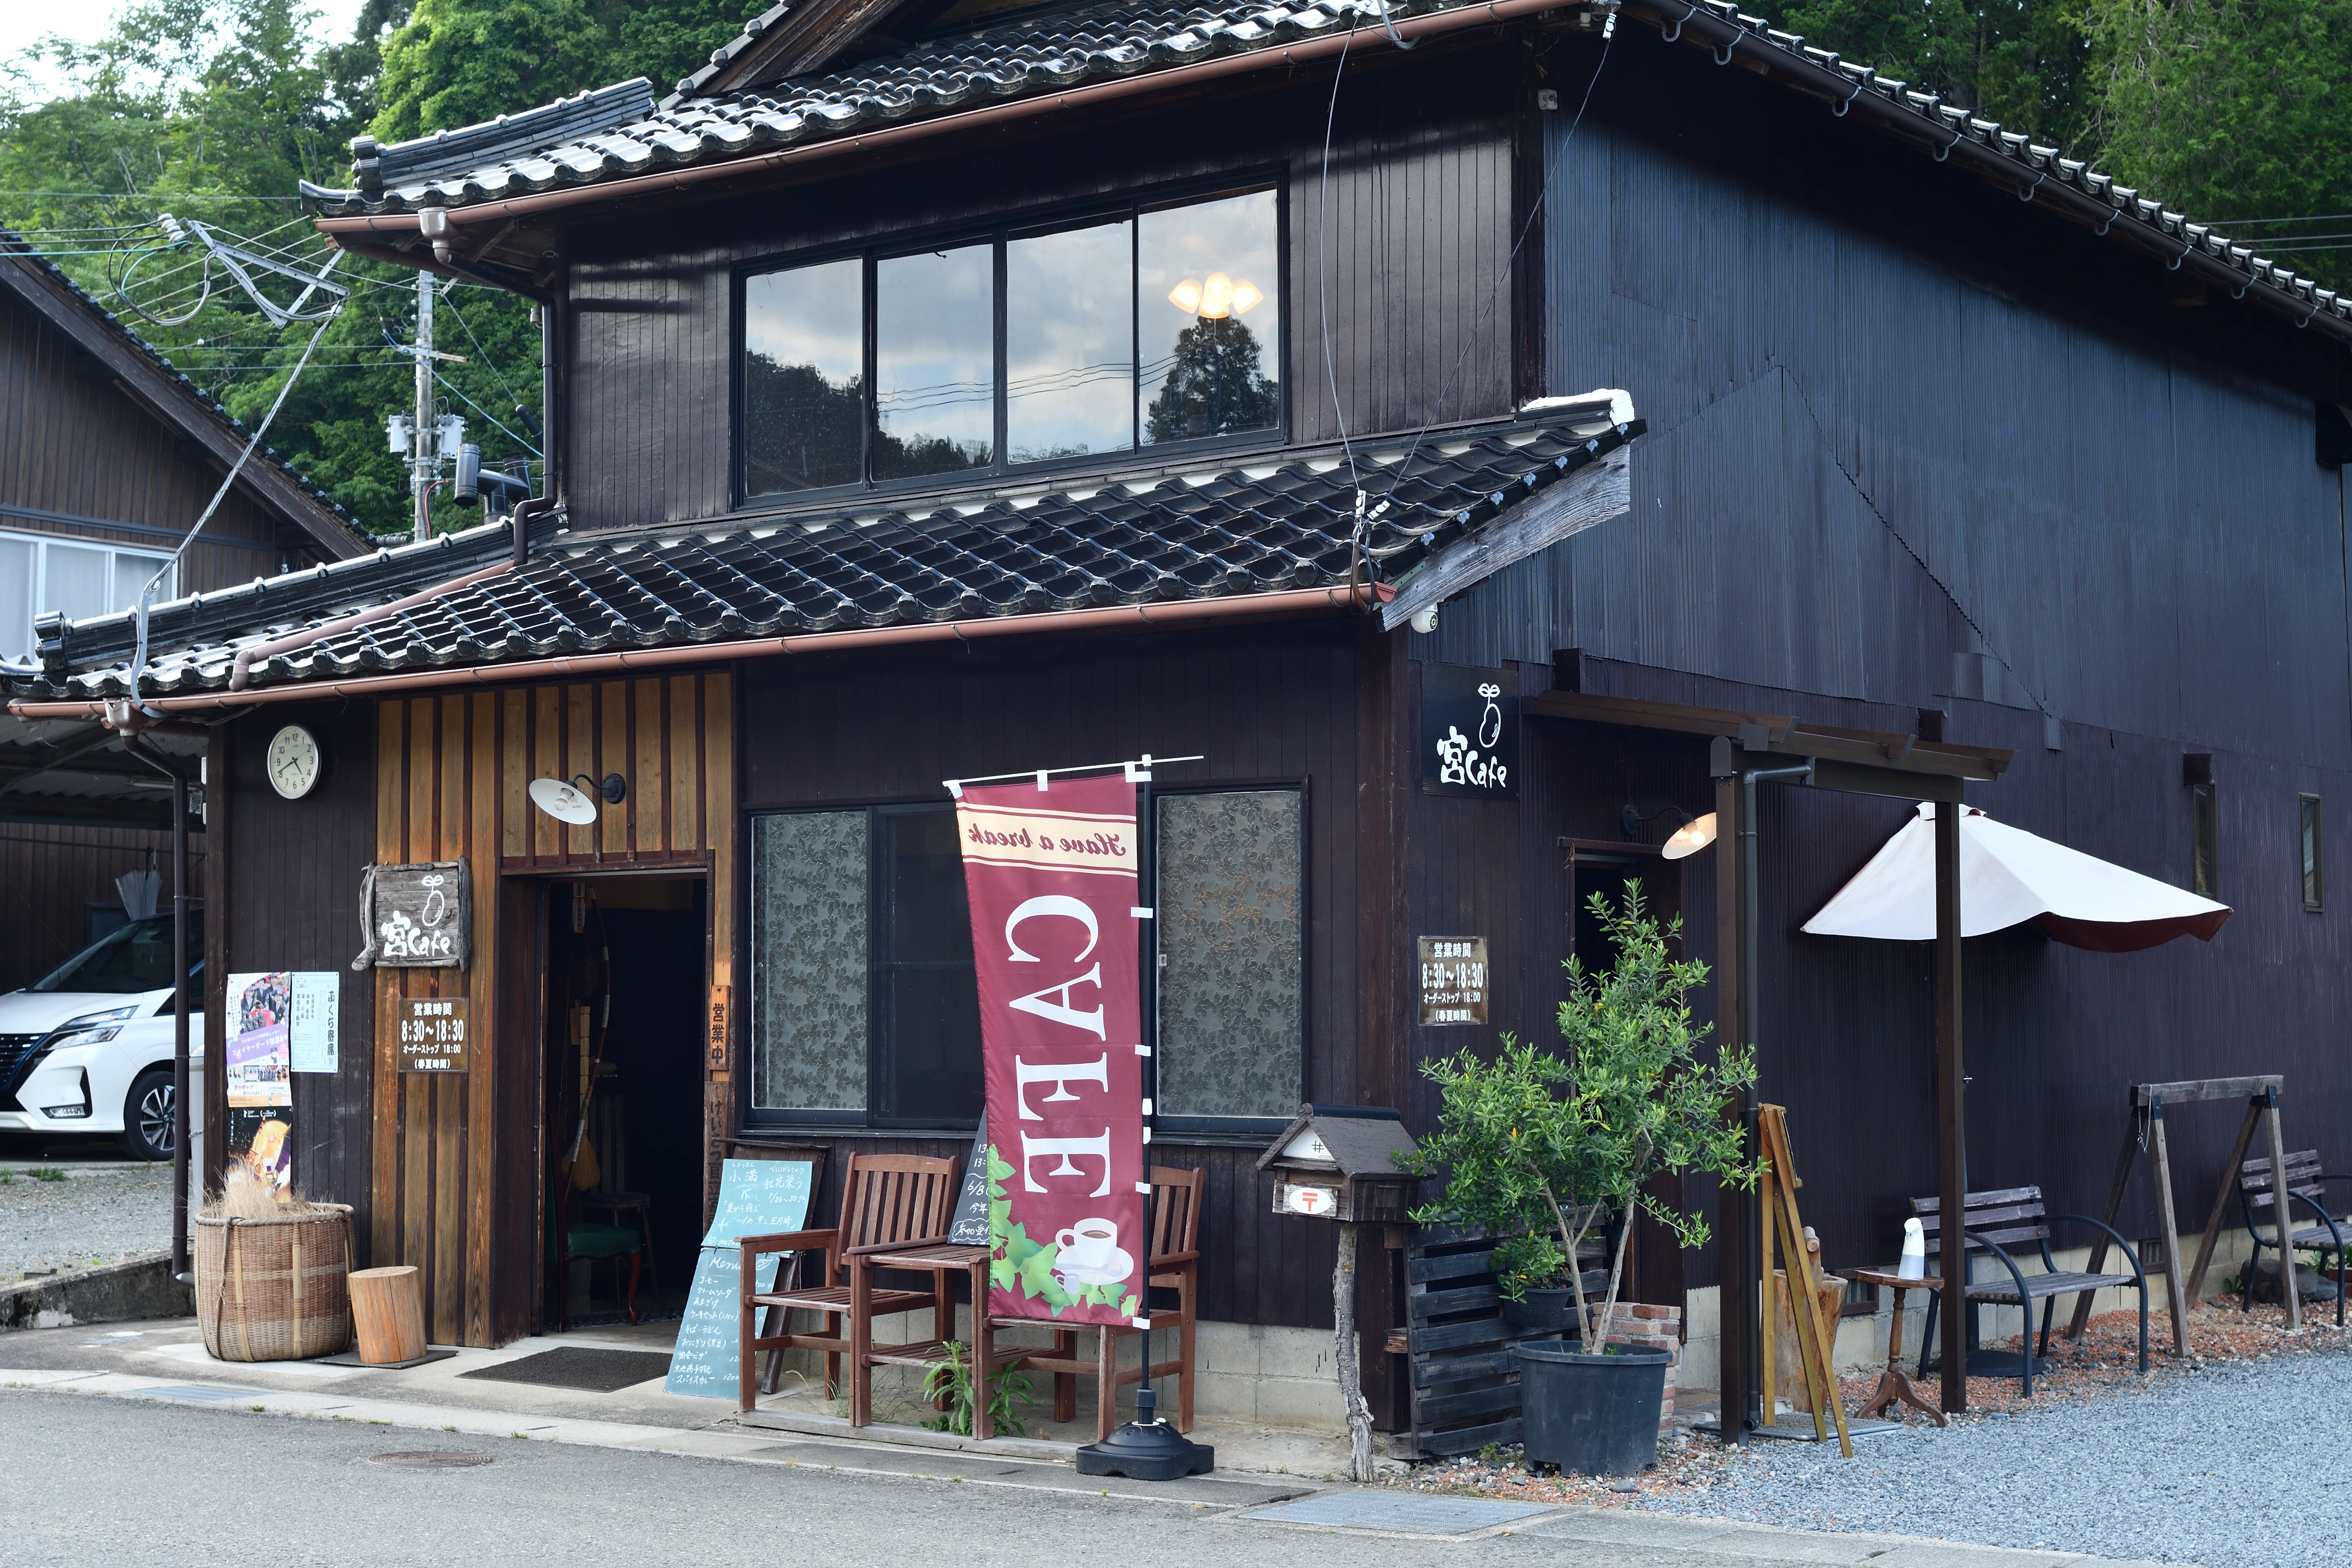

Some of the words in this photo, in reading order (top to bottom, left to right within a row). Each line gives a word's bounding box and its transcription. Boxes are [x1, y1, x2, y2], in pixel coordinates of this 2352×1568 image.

[285, 737, 290, 745] 11
[292, 733, 298, 741] 12
[279, 746, 285, 754] 10
[308, 744, 311, 752] 2
[277, 758, 280, 766] 9
[279, 770, 283, 778] 8
[301, 778, 305, 786] 5
[1434, 942, 1471, 958] 営業時間
[1424, 991, 1460, 1004] オーダーストップ
[1463, 991, 1481, 1003] 18:00
[414, 1002, 452, 1016] 営業時間
[711, 1003, 724, 1064] 営業中
[403, 1043, 440, 1054] オーダーストップ
[443, 1044, 461, 1054] 18:00
[729, 1169, 758, 1183] 小満
[764, 1175, 803, 1191] 紅花栄う
